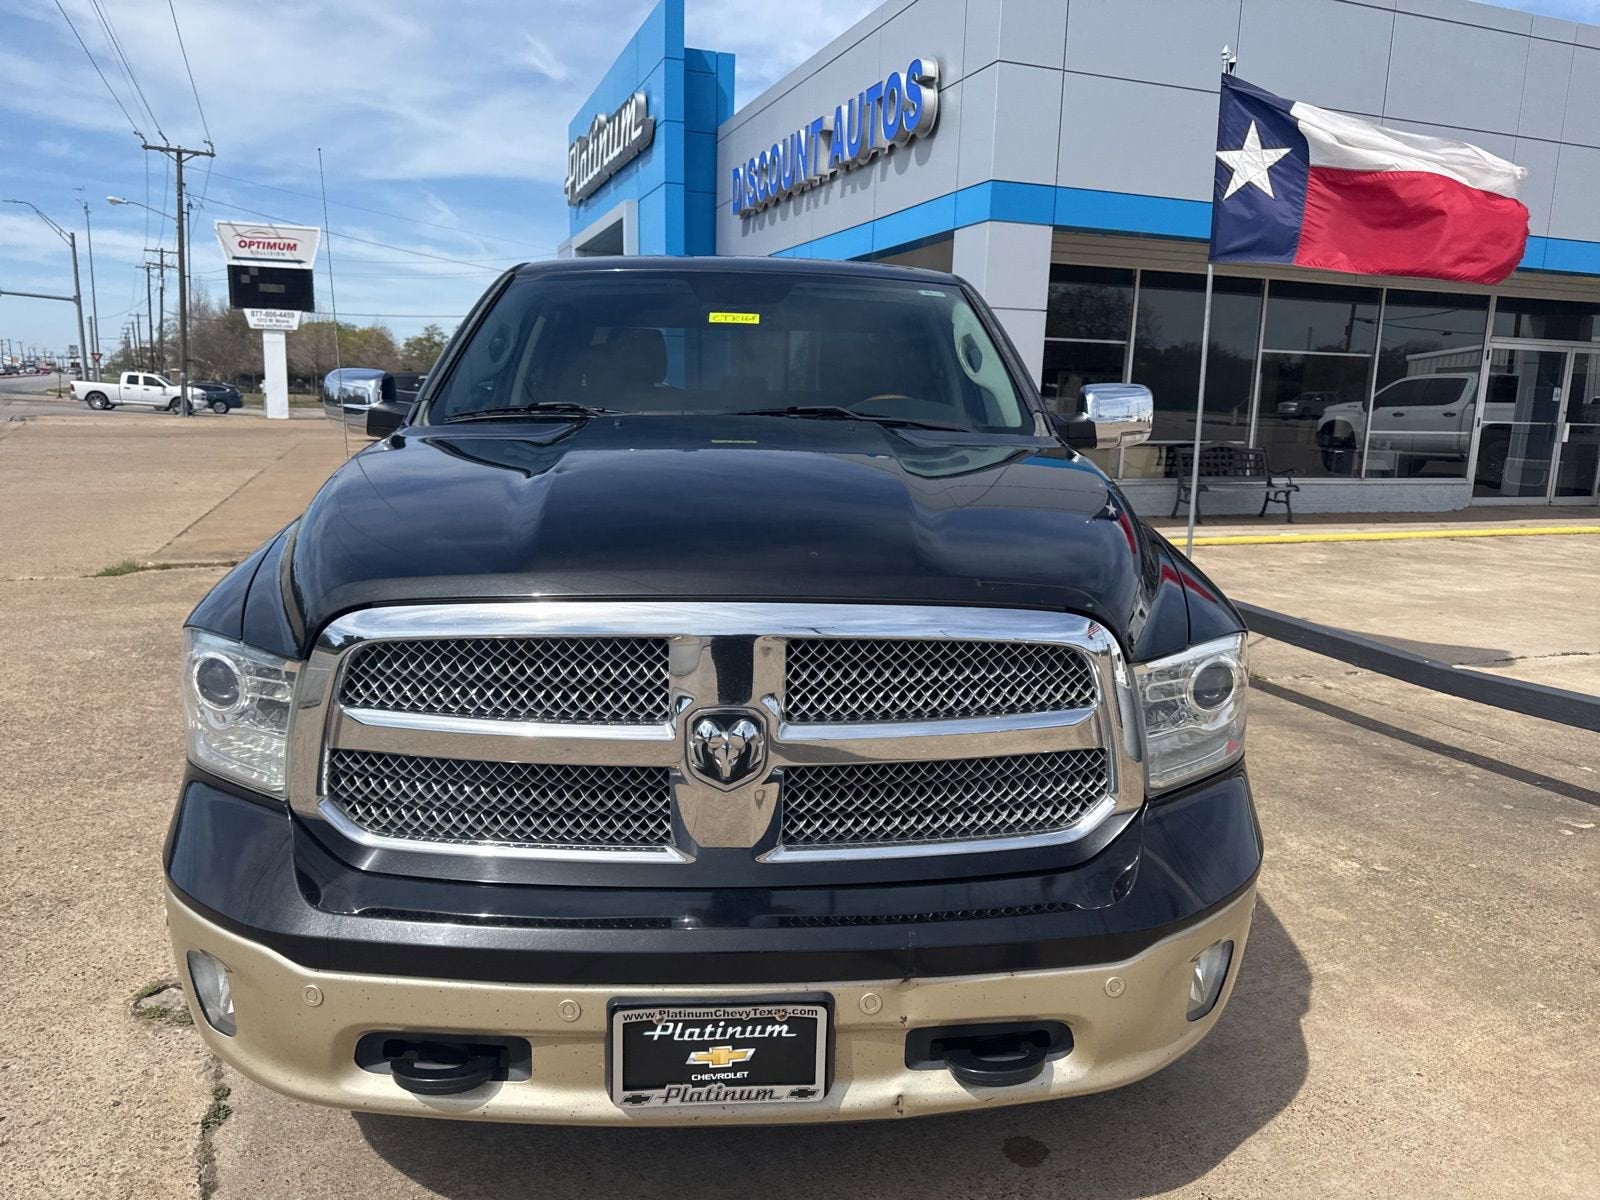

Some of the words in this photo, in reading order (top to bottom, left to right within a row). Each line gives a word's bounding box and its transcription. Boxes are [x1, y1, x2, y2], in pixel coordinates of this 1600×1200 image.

[732, 116, 825, 215] DISCOUNT
[829, 58, 925, 169] AUTOS
[565, 98, 644, 201] Platinum
[238, 239, 297, 252] OPTIMUM
[643, 1021, 797, 1041] Platinum
[691, 1071, 749, 1081] CHEVROLET
[656, 1085, 783, 1104] Platinum
